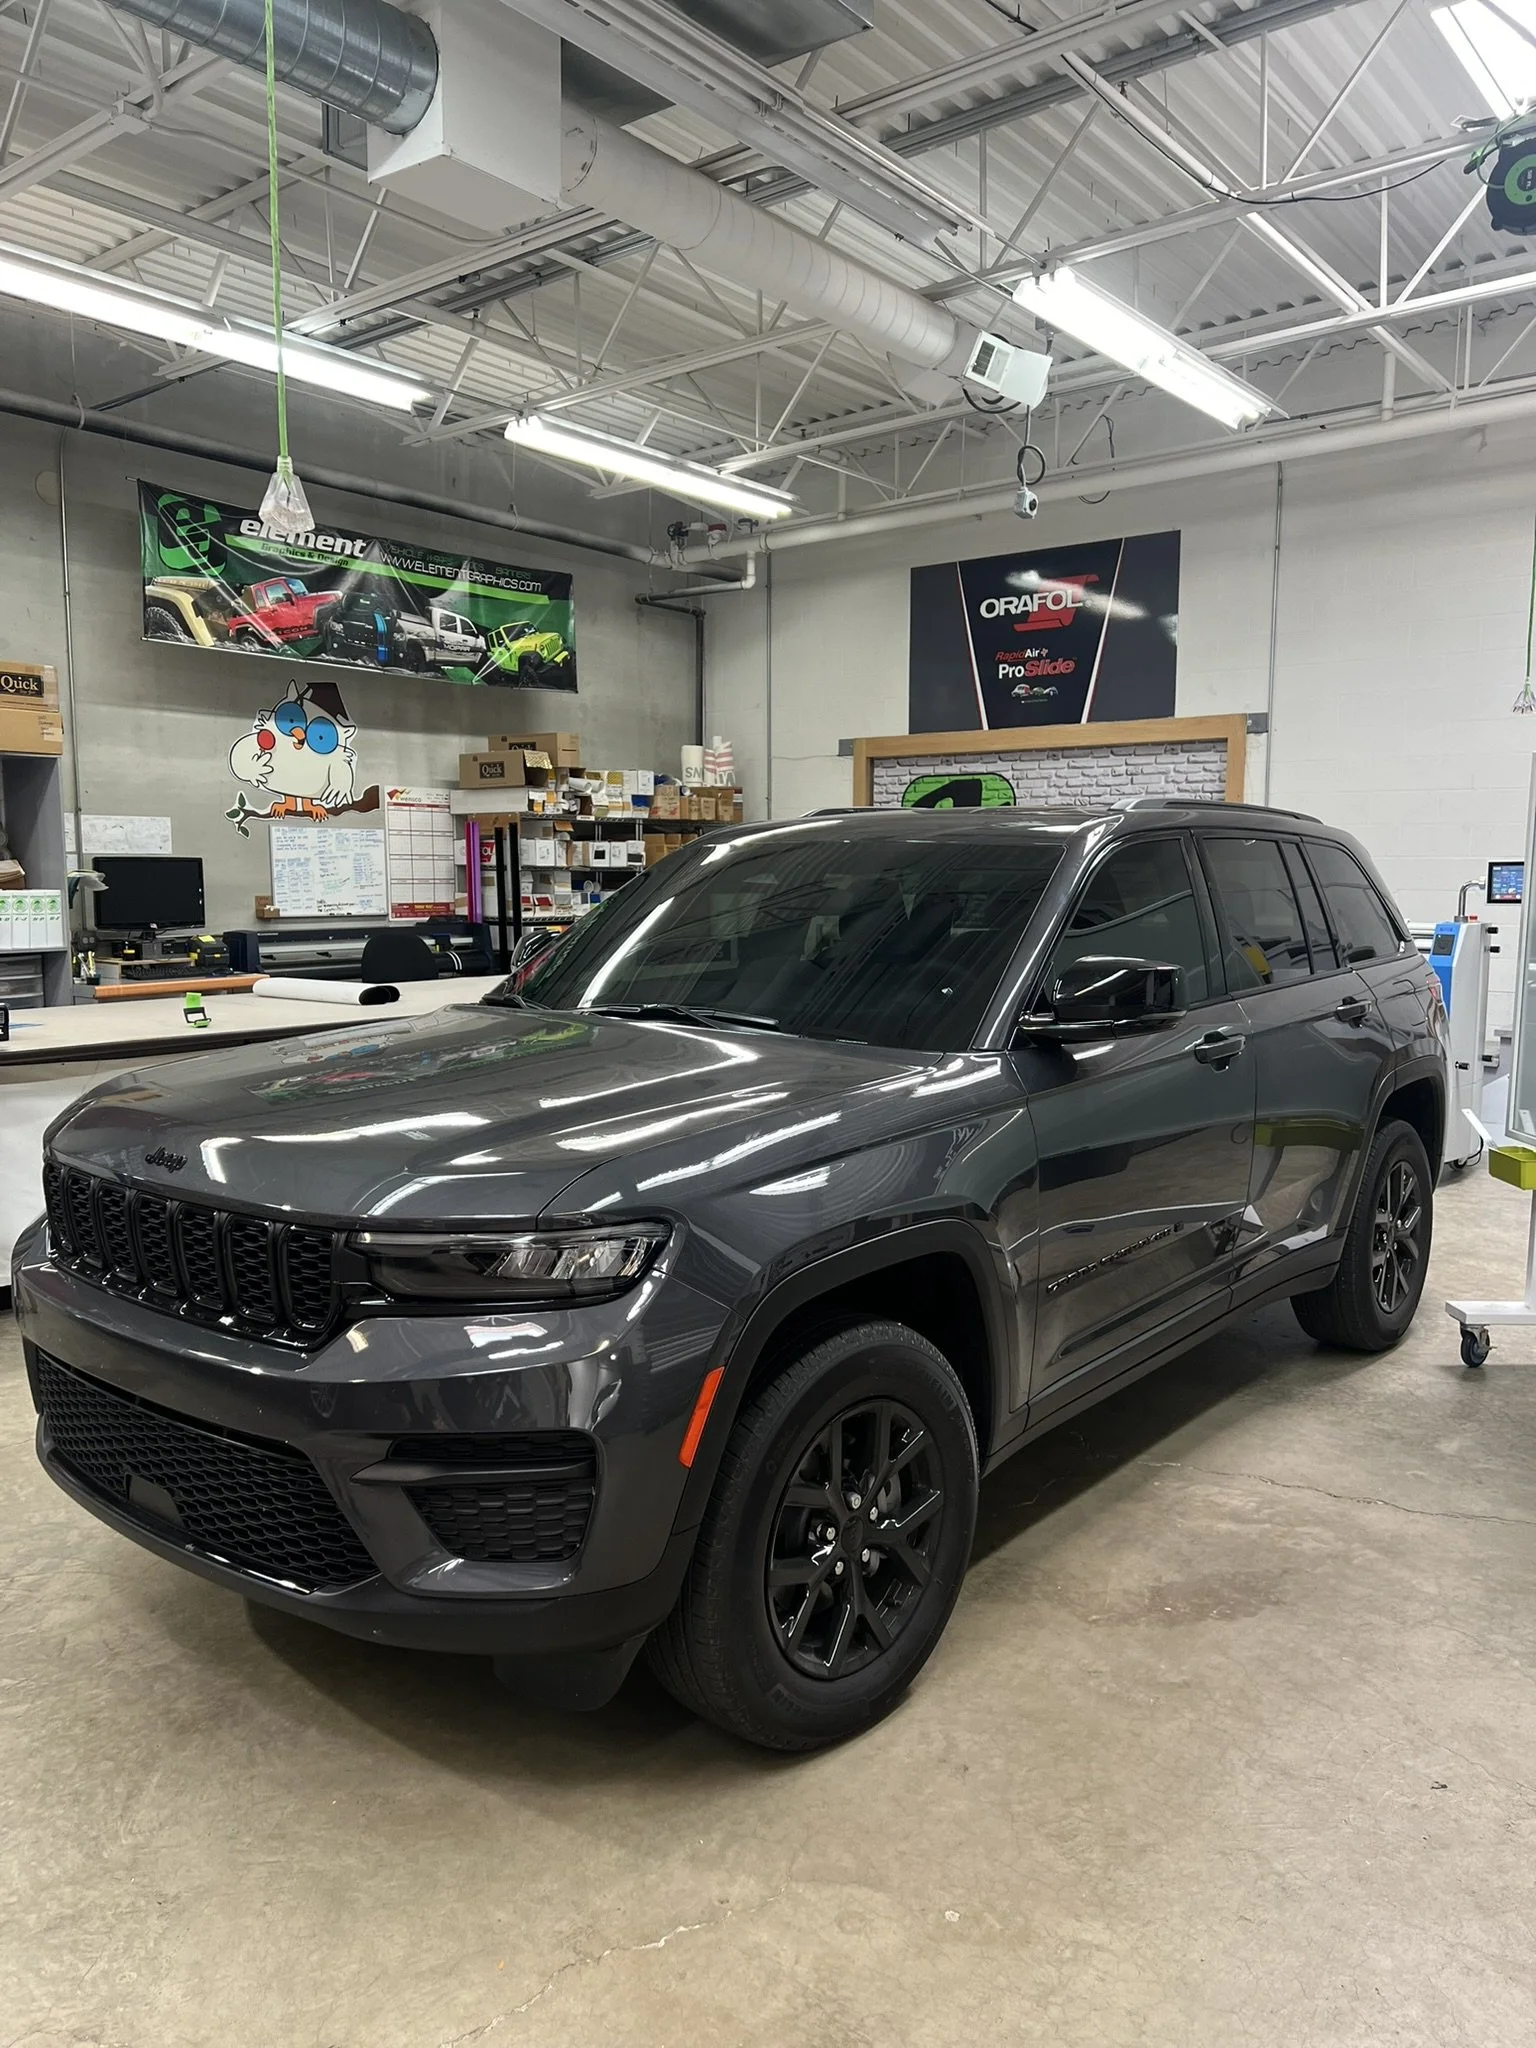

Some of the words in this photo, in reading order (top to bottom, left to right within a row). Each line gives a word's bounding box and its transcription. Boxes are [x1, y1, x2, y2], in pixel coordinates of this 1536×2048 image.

[240, 518, 367, 558] element
[261, 542, 307, 558] Graphics
[317, 552, 349, 567] Design
[979, 589, 1084, 619] ORAFOL
[0, 675, 39, 692] Quick
[482, 763, 502, 777] Quick
[145, 1146, 188, 1173] Jeep
